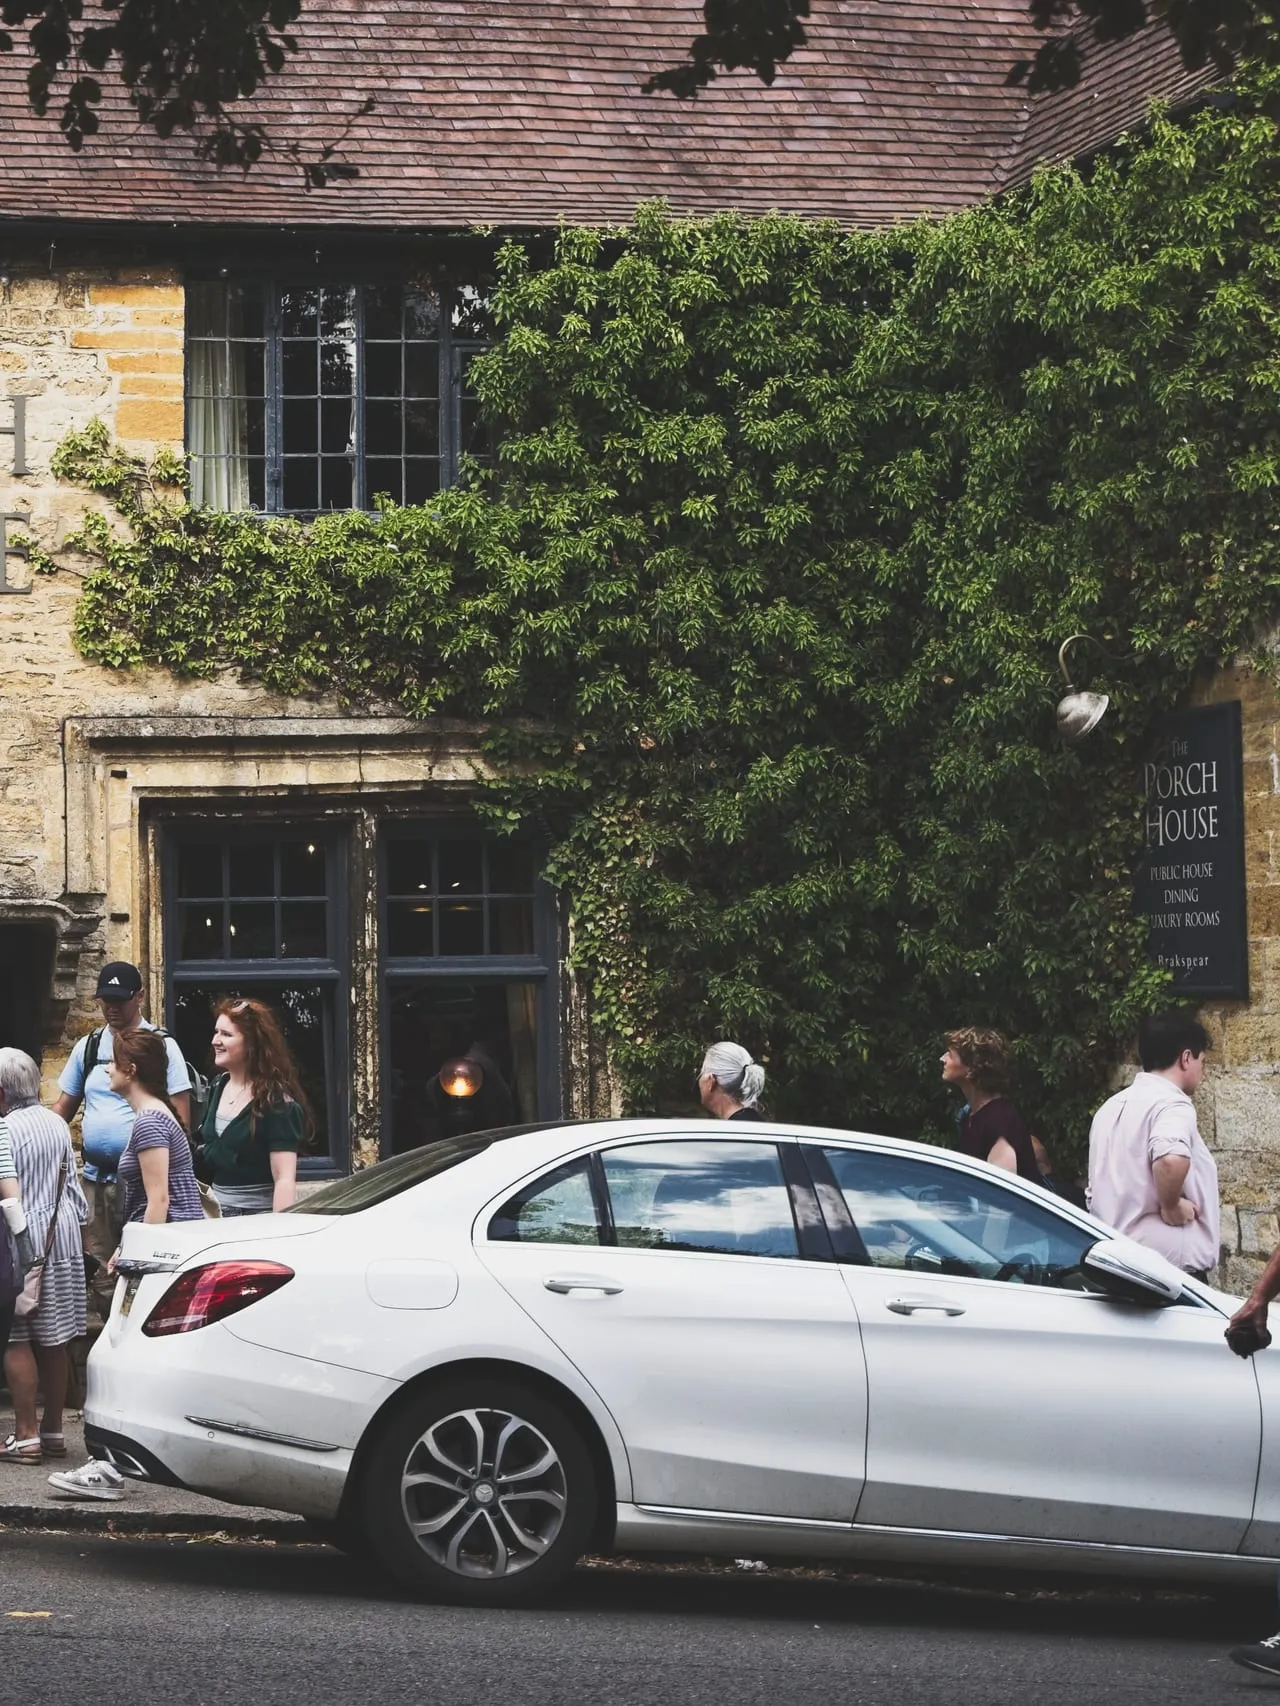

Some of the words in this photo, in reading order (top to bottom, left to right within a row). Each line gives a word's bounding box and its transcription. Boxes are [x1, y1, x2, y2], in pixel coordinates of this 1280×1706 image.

[1172, 740, 1188, 758] THE
[1144, 761, 1217, 799] PORCH
[1146, 804, 1218, 848] HOUSE
[1150, 864, 1181, 881] PUBLIC
[1182, 862, 1213, 879] HOUSE
[1164, 887, 1199, 904] DINING
[1150, 913, 1182, 928] UXURY
[1185, 910, 1220, 927] ROOMS
[1158, 954, 1209, 969] Brakspear
